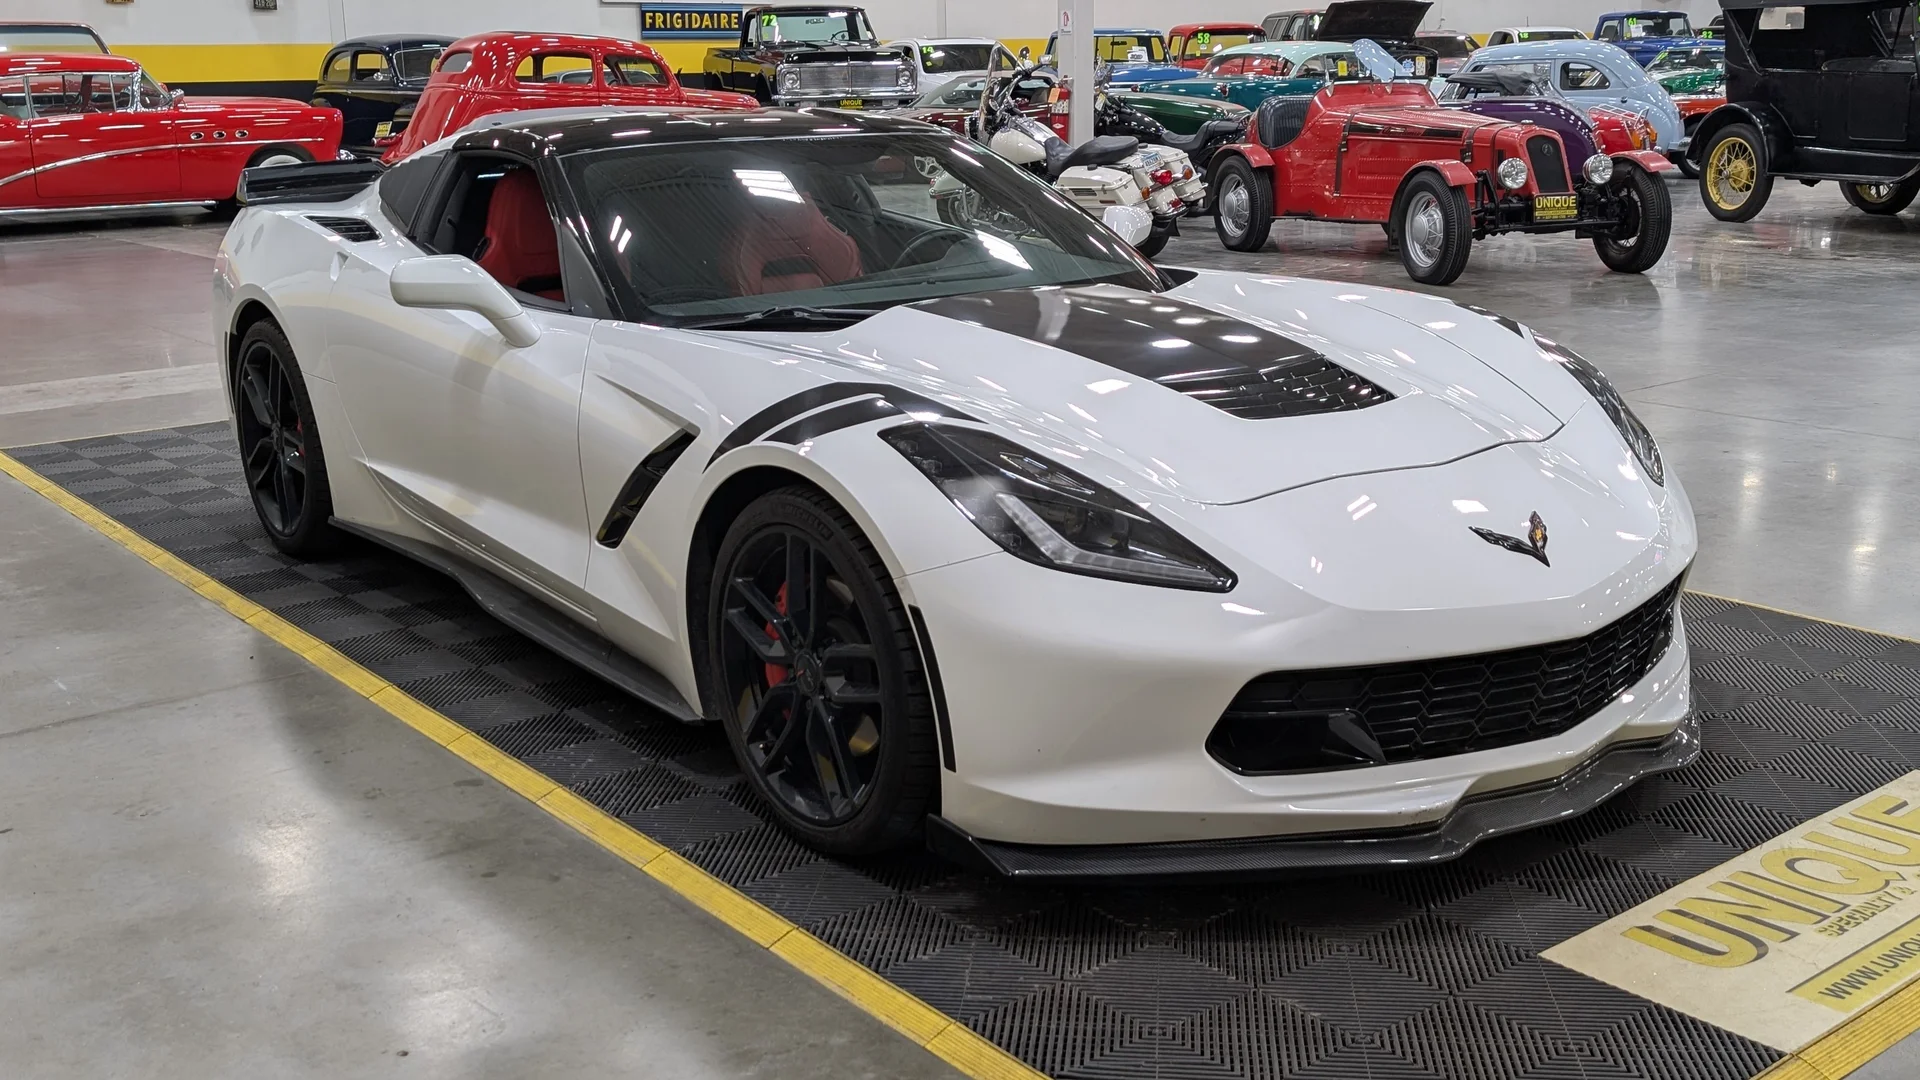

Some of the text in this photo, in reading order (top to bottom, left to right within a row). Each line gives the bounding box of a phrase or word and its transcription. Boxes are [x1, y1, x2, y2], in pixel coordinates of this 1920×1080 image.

[645, 12, 739, 29] FRIGIDAIRE
[762, 14, 778, 27] 72
[1628, 17, 1637, 26] 61
[1196, 32, 1211, 44] 58
[1535, 195, 1577, 208] UNIQUE
[1814, 890, 1904, 937] SPECIALTY
